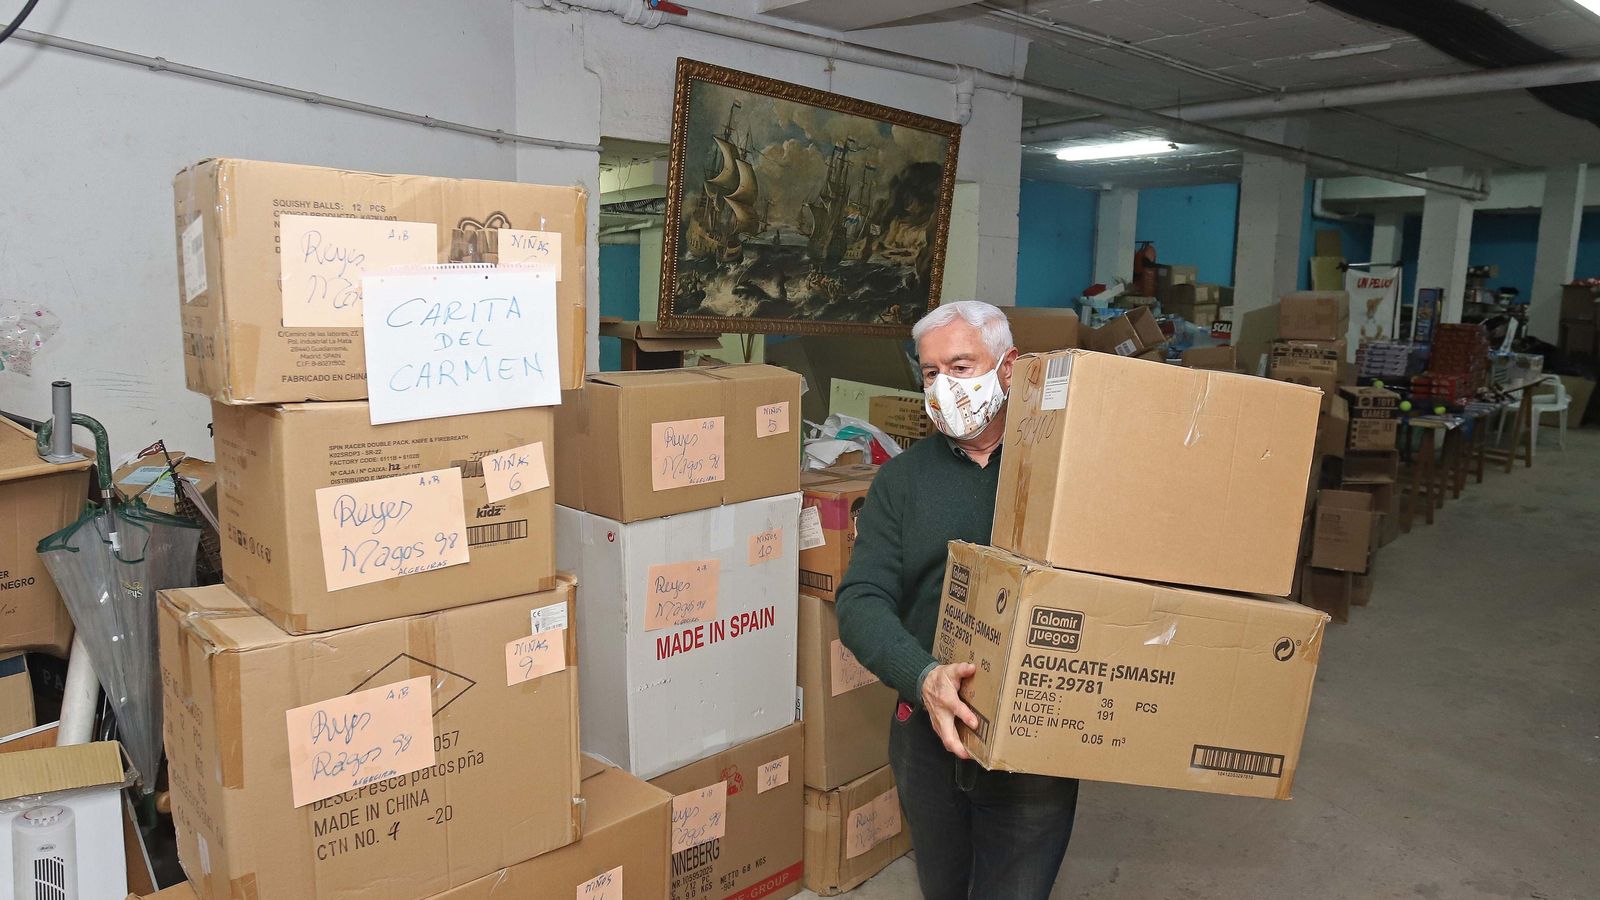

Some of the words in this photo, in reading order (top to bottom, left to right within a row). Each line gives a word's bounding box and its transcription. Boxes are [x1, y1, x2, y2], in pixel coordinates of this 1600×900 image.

[272, 199, 311, 209] SQUISHY
[352, 203, 362, 212] 12
[369, 204, 386, 213] PCS
[386, 296, 522, 328] CARITA
[433, 328, 493, 351] DEL
[281, 374, 330, 382] FABRICADO
[388, 352, 545, 392] CARMEN
[1361, 409, 1391, 418] GAMES
[767, 419, 777, 433] 5
[509, 472, 522, 491] 6
[341, 539, 425, 575] Magos
[434, 532, 459, 556] 98
[758, 545, 772, 558] 10
[1, 577, 35, 591] NEGRO
[945, 602, 976, 630] AGUACATE
[1035, 610, 1079, 629] falomir
[656, 625, 704, 661] MADE
[709, 619, 725, 644] IN
[730, 606, 775, 638] SPAIN
[1030, 629, 1076, 645] juegos
[1020, 653, 1108, 678] AGUACATE
[1110, 664, 1176, 685] ¡SMASH!
[1018, 671, 1052, 689] REF:
[1055, 676, 1104, 694] 29781
[1013, 700, 1022, 711] N
[1024, 702, 1054, 715] LOTE
[1096, 710, 1114, 721] 191
[1100, 698, 1114, 709] 36
[1135, 701, 1158, 714] PCS
[1010, 713, 1044, 726] MADE
[1047, 717, 1059, 727] IN
[1061, 719, 1085, 731] PRC
[1009, 726, 1032, 738] VOL
[1081, 733, 1103, 745] 0.05
[411, 760, 455, 787] patos
[314, 808, 359, 838] MADE
[366, 802, 380, 822] IN
[386, 788, 430, 815] CHINA
[317, 836, 349, 861] CTN
[355, 828, 380, 850] NO.
[701, 882, 713, 894] KGS
[720, 869, 739, 885] NETTO
[755, 856, 767, 868] KGS
